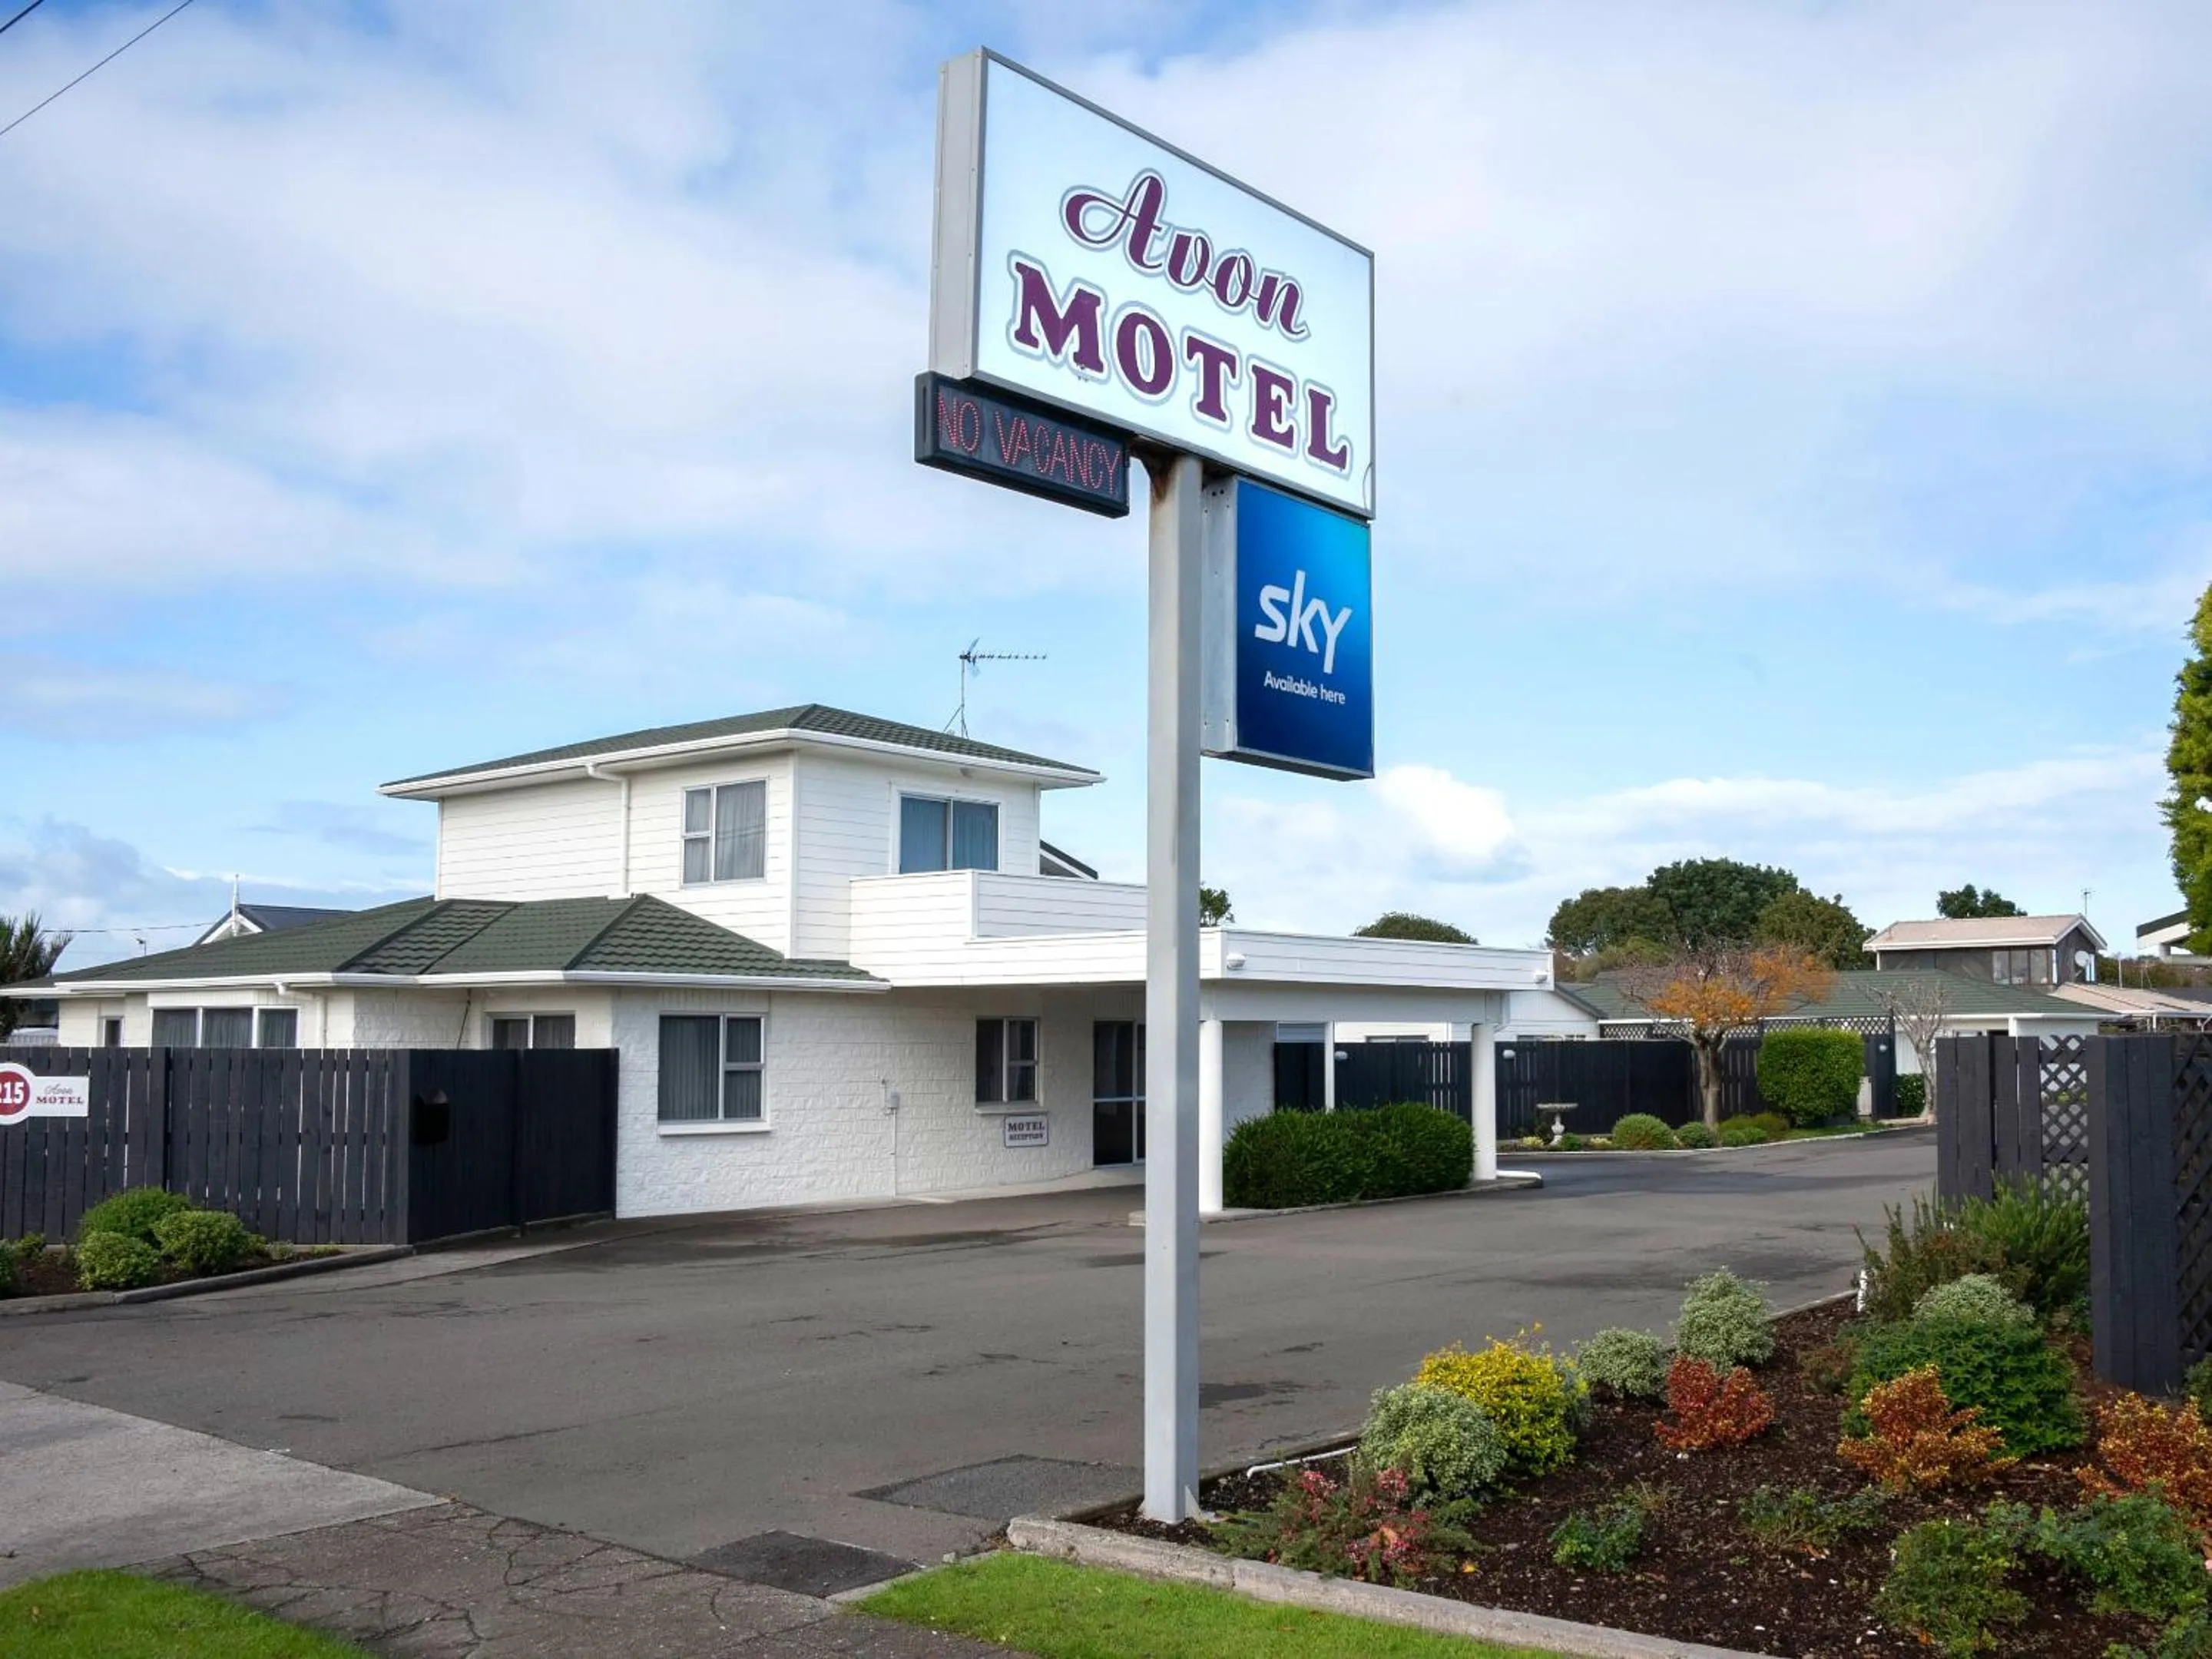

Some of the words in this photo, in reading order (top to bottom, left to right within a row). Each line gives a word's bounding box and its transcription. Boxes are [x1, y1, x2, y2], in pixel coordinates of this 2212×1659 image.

[1065, 175, 1306, 336] Avon
[1014, 261, 1348, 471] MOTEL
[938, 391, 980, 455] NO
[995, 410, 1122, 495] VACANCY
[1254, 569, 1353, 674] sky
[1263, 670, 1318, 699] Available
[1320, 684, 1346, 704] here
[0, 1081, 25, 1104] 15
[1008, 1121, 1045, 1132] MOTEL
